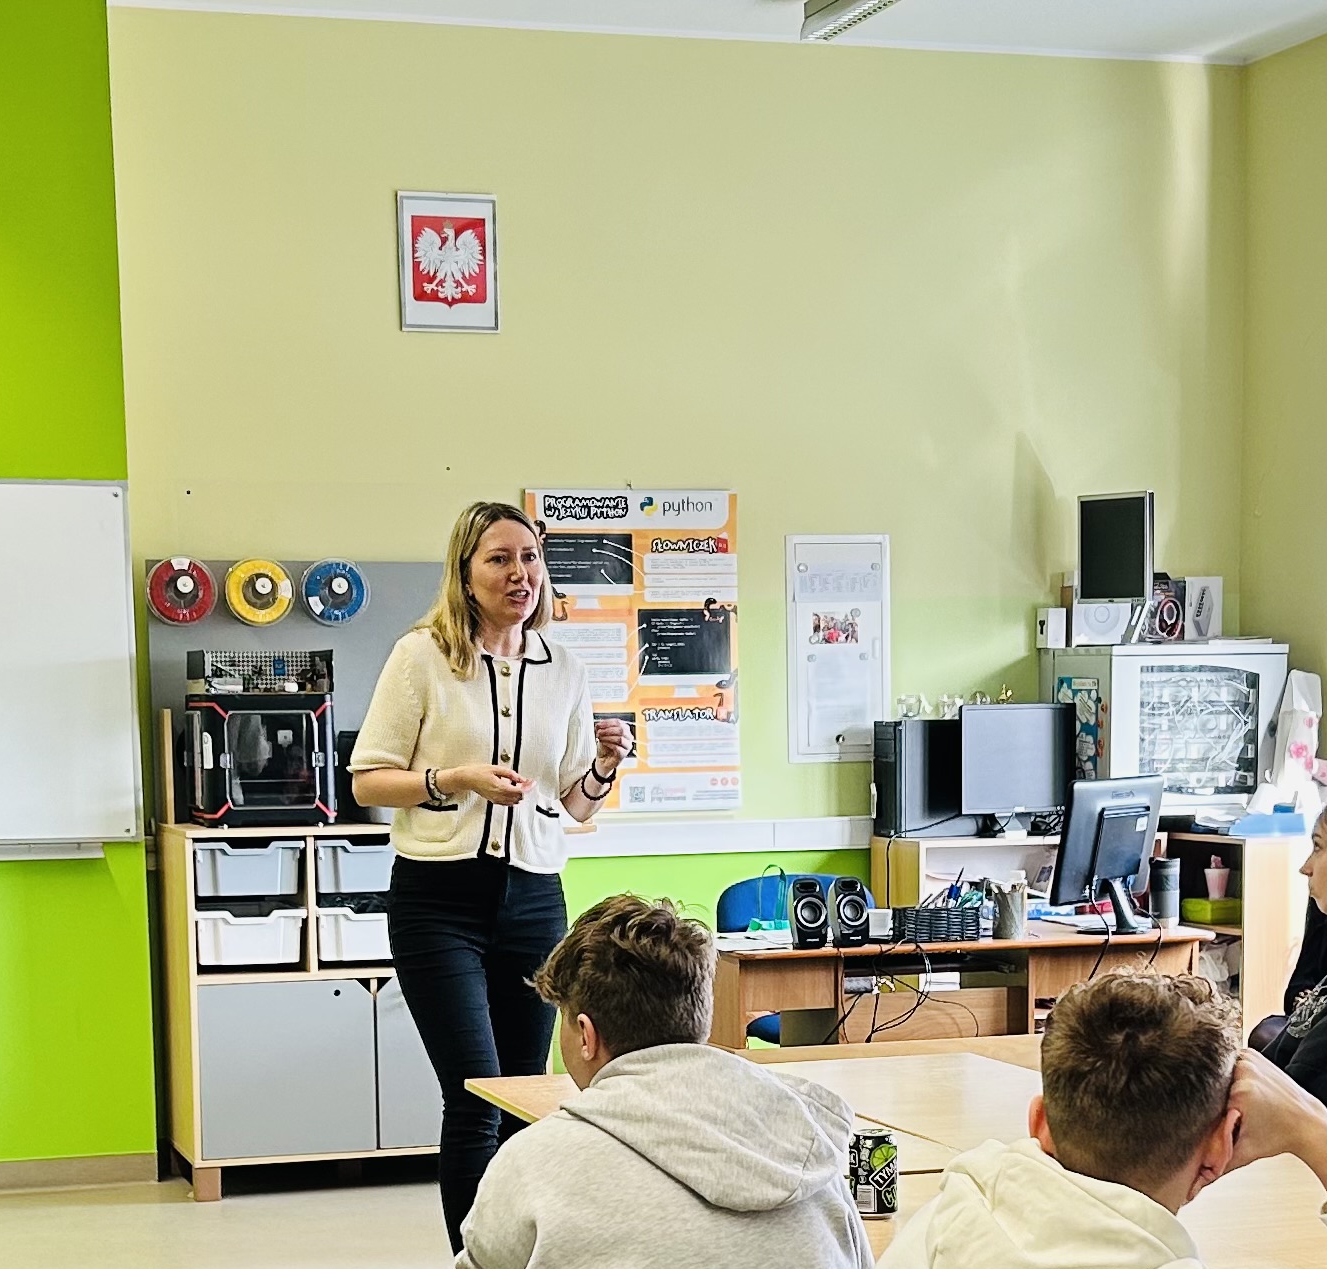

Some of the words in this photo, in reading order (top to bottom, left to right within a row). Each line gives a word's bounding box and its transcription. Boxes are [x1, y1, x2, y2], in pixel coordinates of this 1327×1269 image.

[544, 496, 627, 509] PROGRAMOWANIE
[662, 496, 713, 516] python
[590, 507, 627, 518] PYTHON
[652, 537, 717, 553] SŁOWNICZEK
[642, 707, 715, 721] TRANSLATOR
[873, 1158, 898, 1184] TYM
